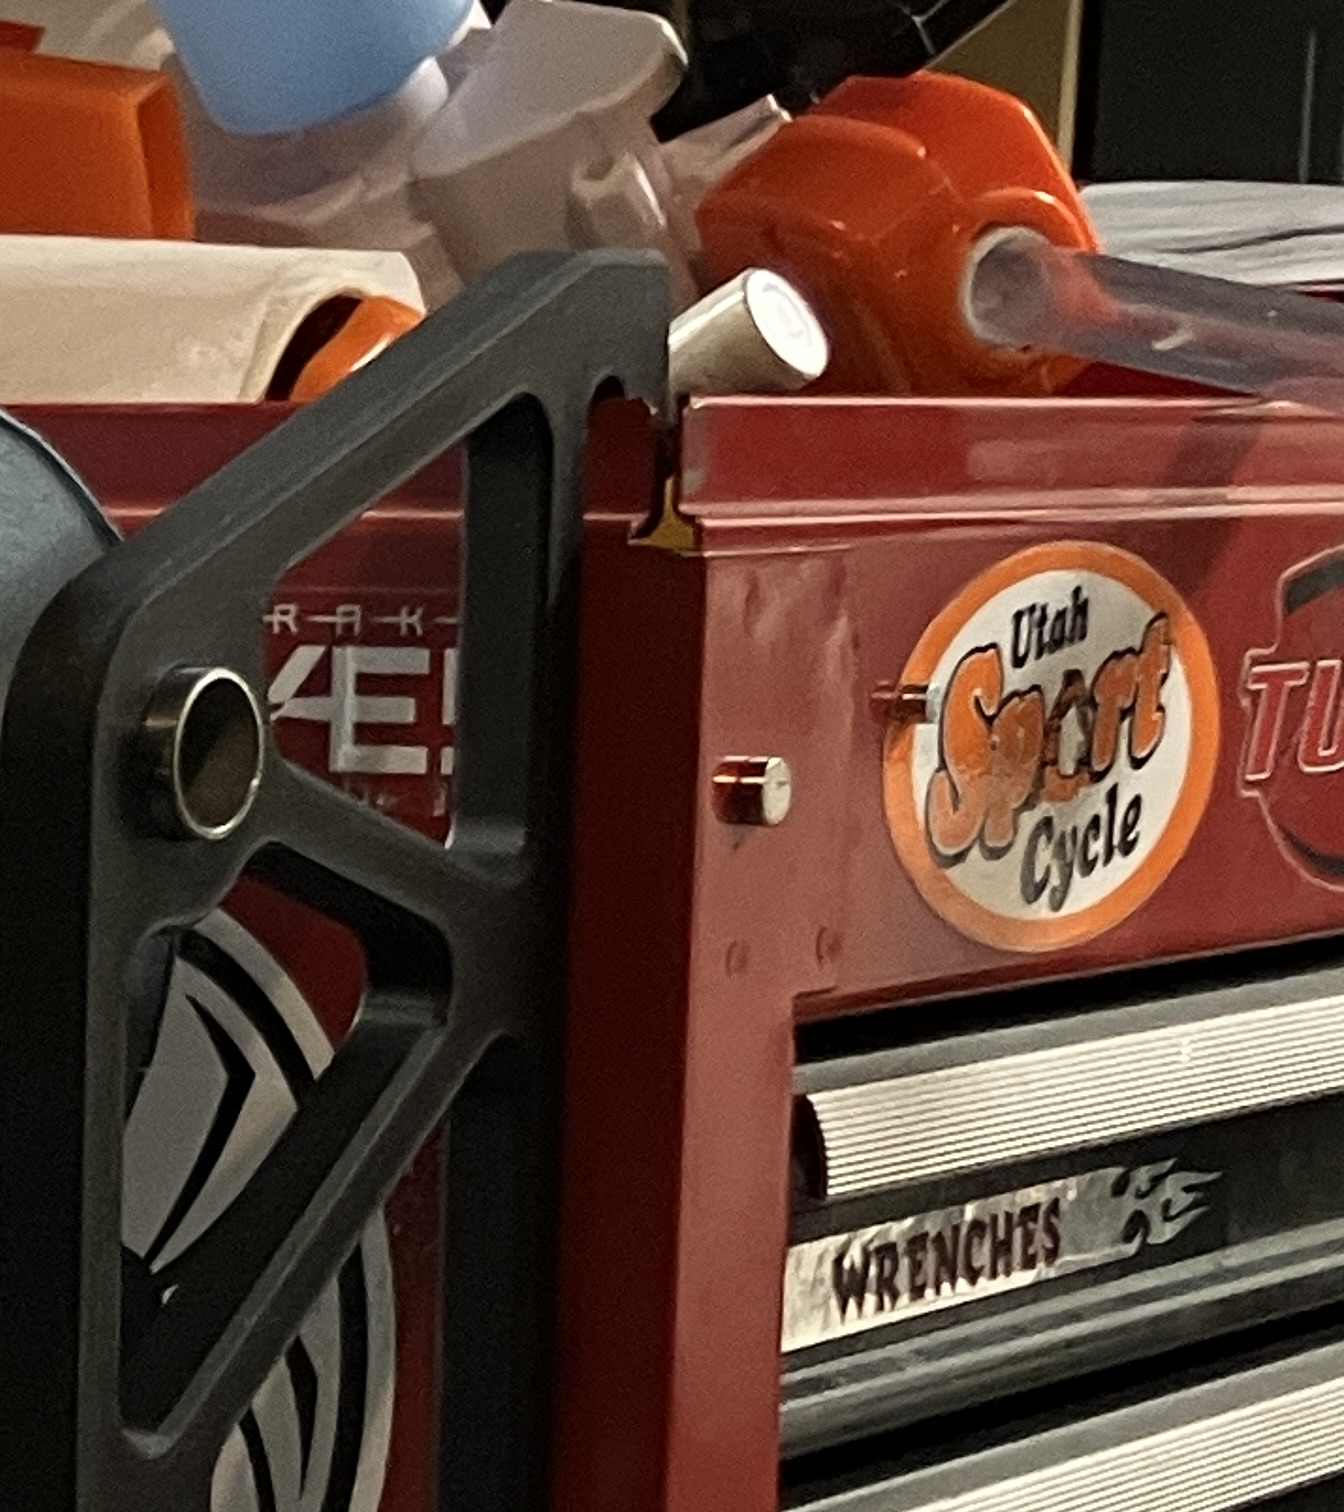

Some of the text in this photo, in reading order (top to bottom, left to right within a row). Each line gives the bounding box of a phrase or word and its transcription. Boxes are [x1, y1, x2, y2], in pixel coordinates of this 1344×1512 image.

[1012, 585, 1090, 669] Utah
[1020, 784, 1144, 912] Cycle
[831, 1196, 1063, 1326] WRENCHES
